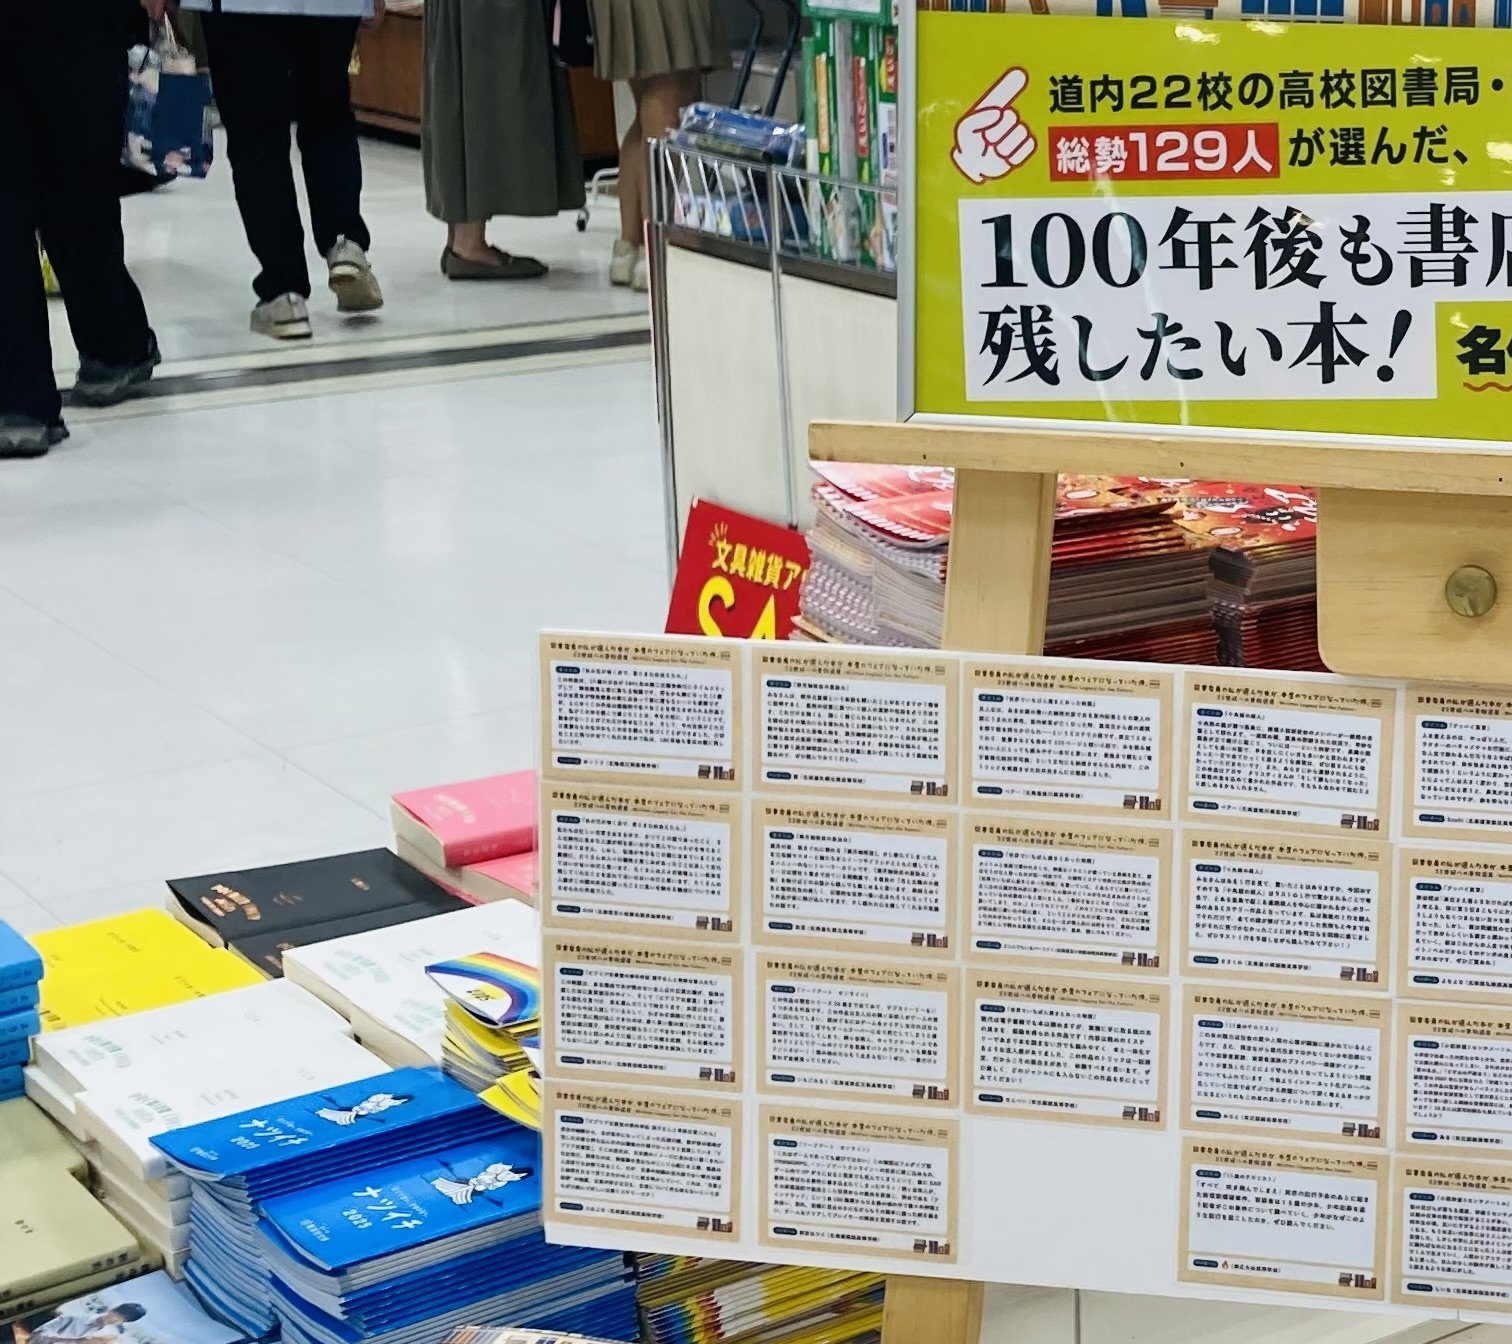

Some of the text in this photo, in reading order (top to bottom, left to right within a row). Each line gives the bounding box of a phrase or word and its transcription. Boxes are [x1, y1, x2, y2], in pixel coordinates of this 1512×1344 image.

[980, 306, 1411, 389] 残したい本!
[352, 1185, 424, 1230] ナツイチ
